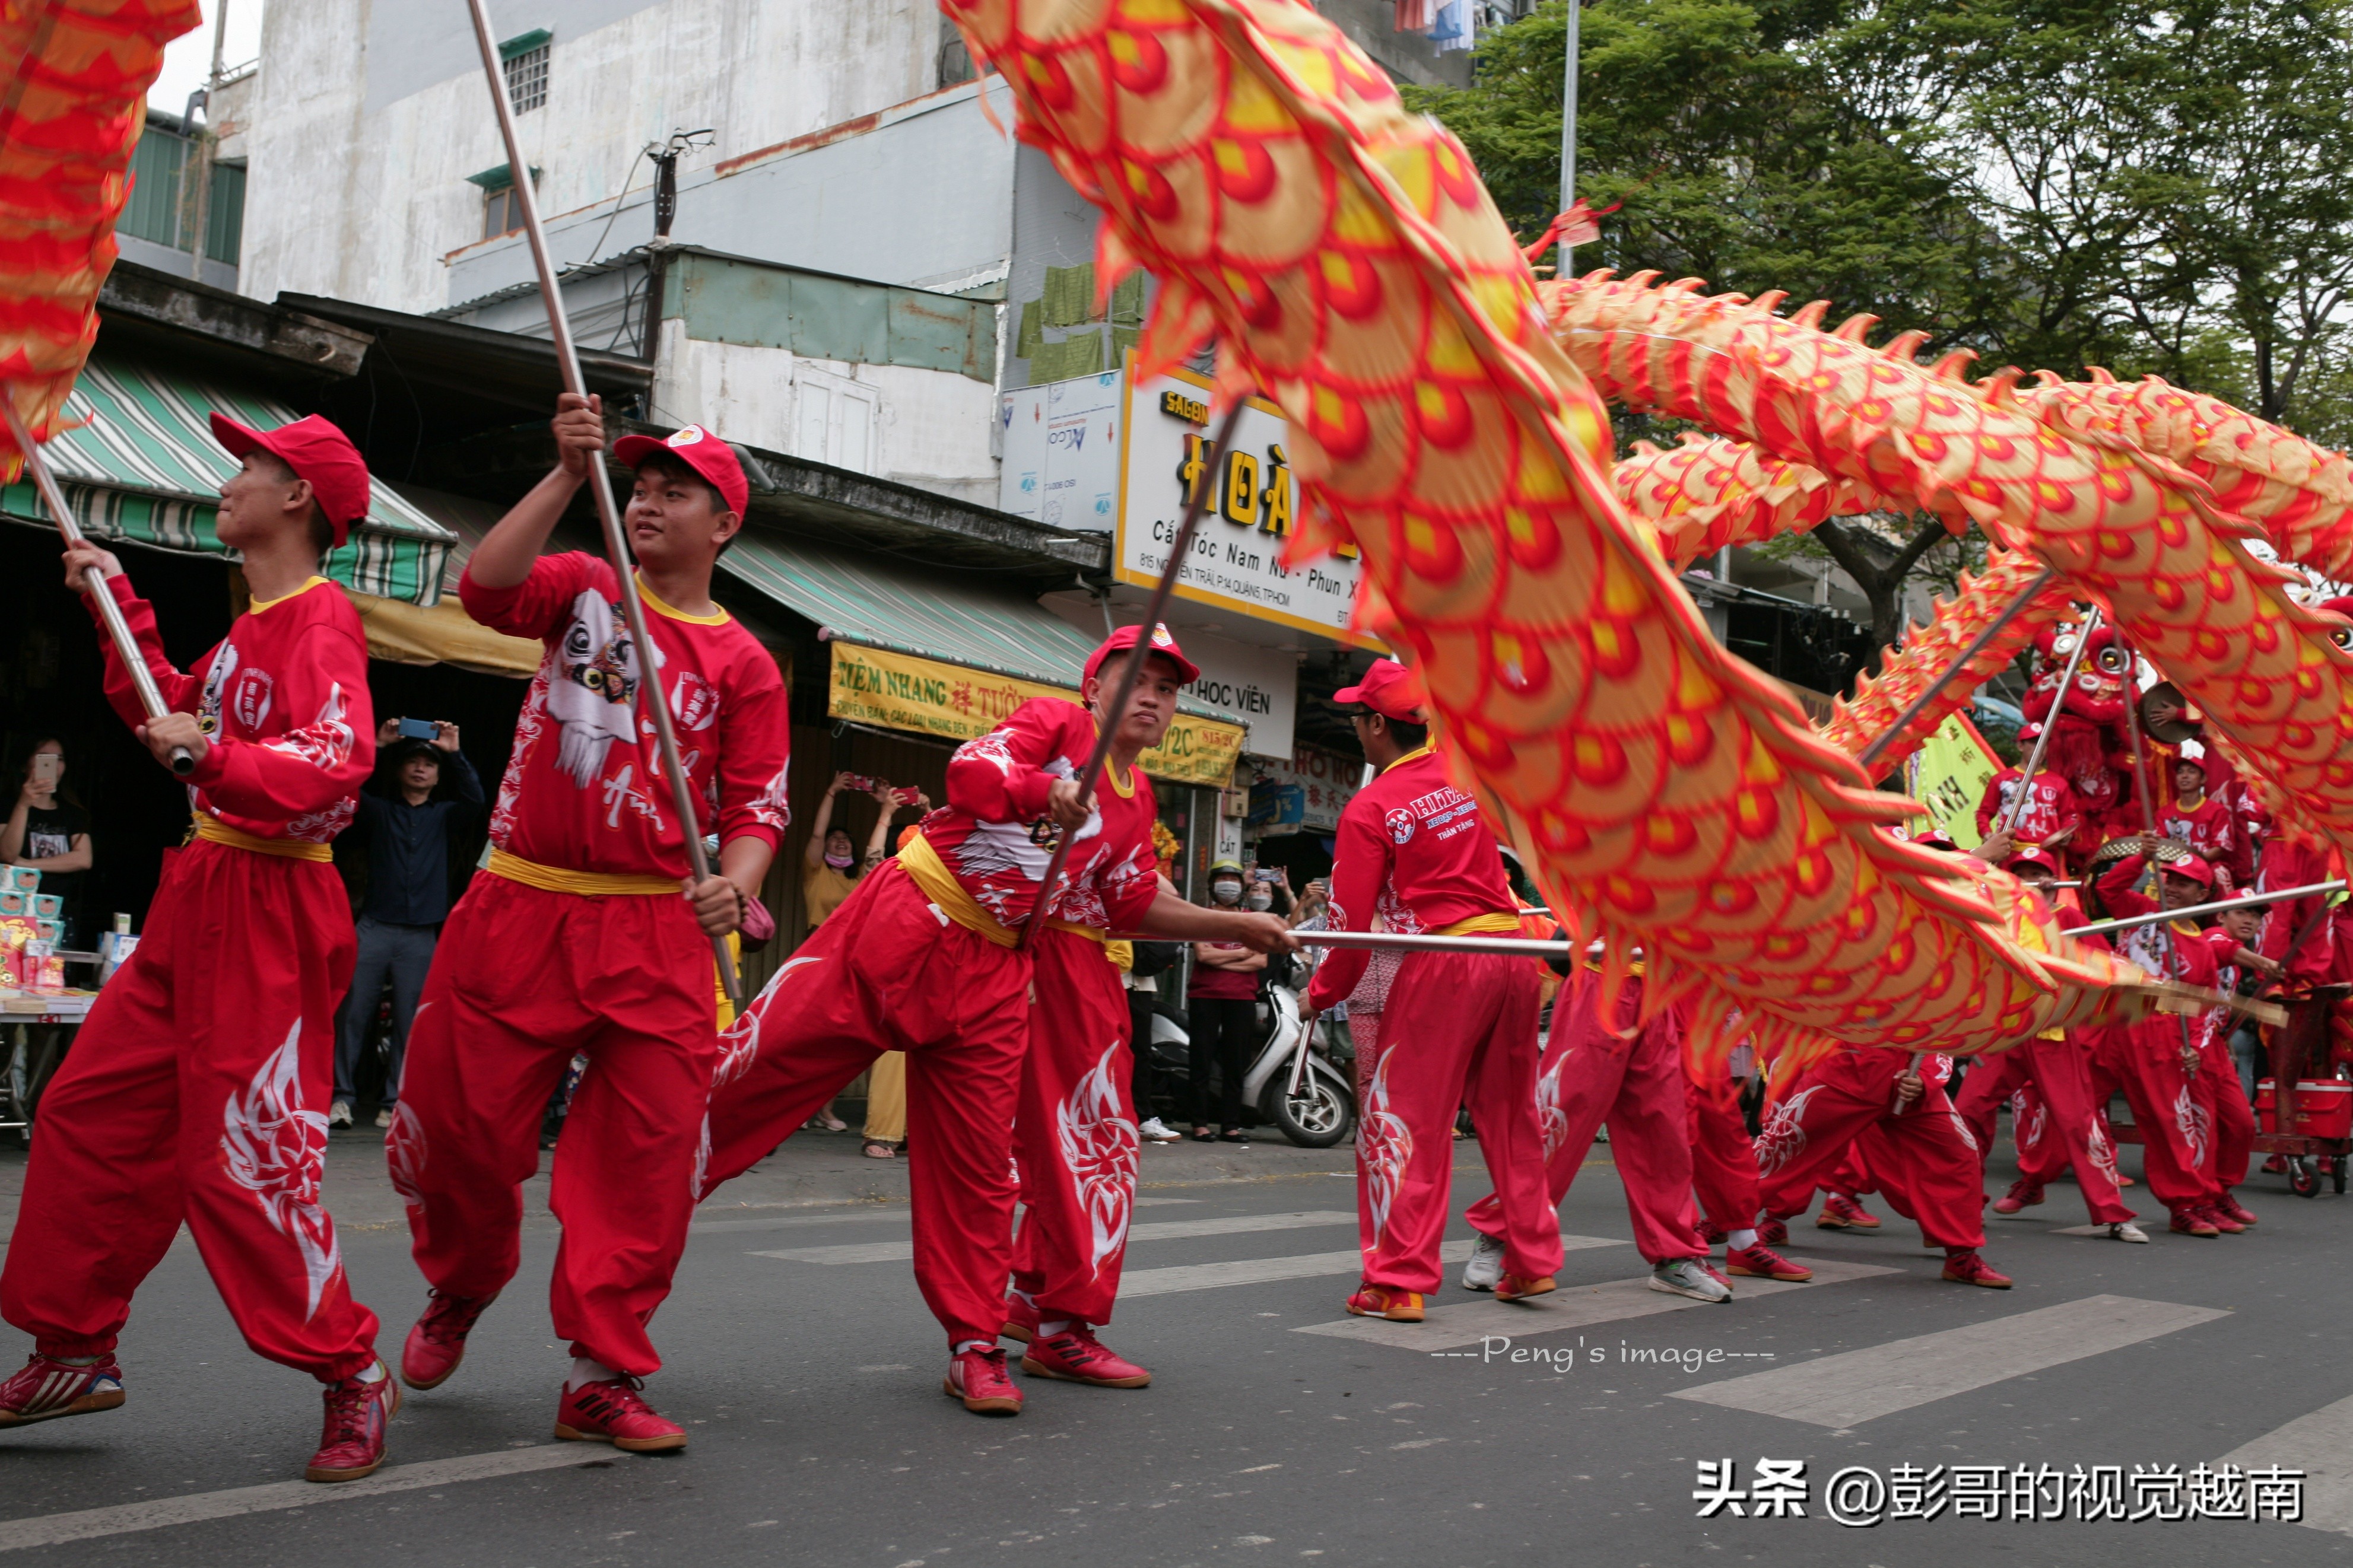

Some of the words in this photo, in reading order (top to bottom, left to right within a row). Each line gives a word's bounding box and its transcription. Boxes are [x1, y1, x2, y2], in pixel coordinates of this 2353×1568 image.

[1162, 391, 1209, 427] SALON
[1140, 553, 1154, 569] 815
[1190, 531, 1217, 558] Tóc
[1226, 542, 1260, 572] Nam
[1307, 568, 1341, 596] Phun
[885, 670, 947, 706] NHANG
[951, 680, 974, 716] 祥
[1426, 817, 1439, 829] XE
[1456, 804, 1468, 816] XE
